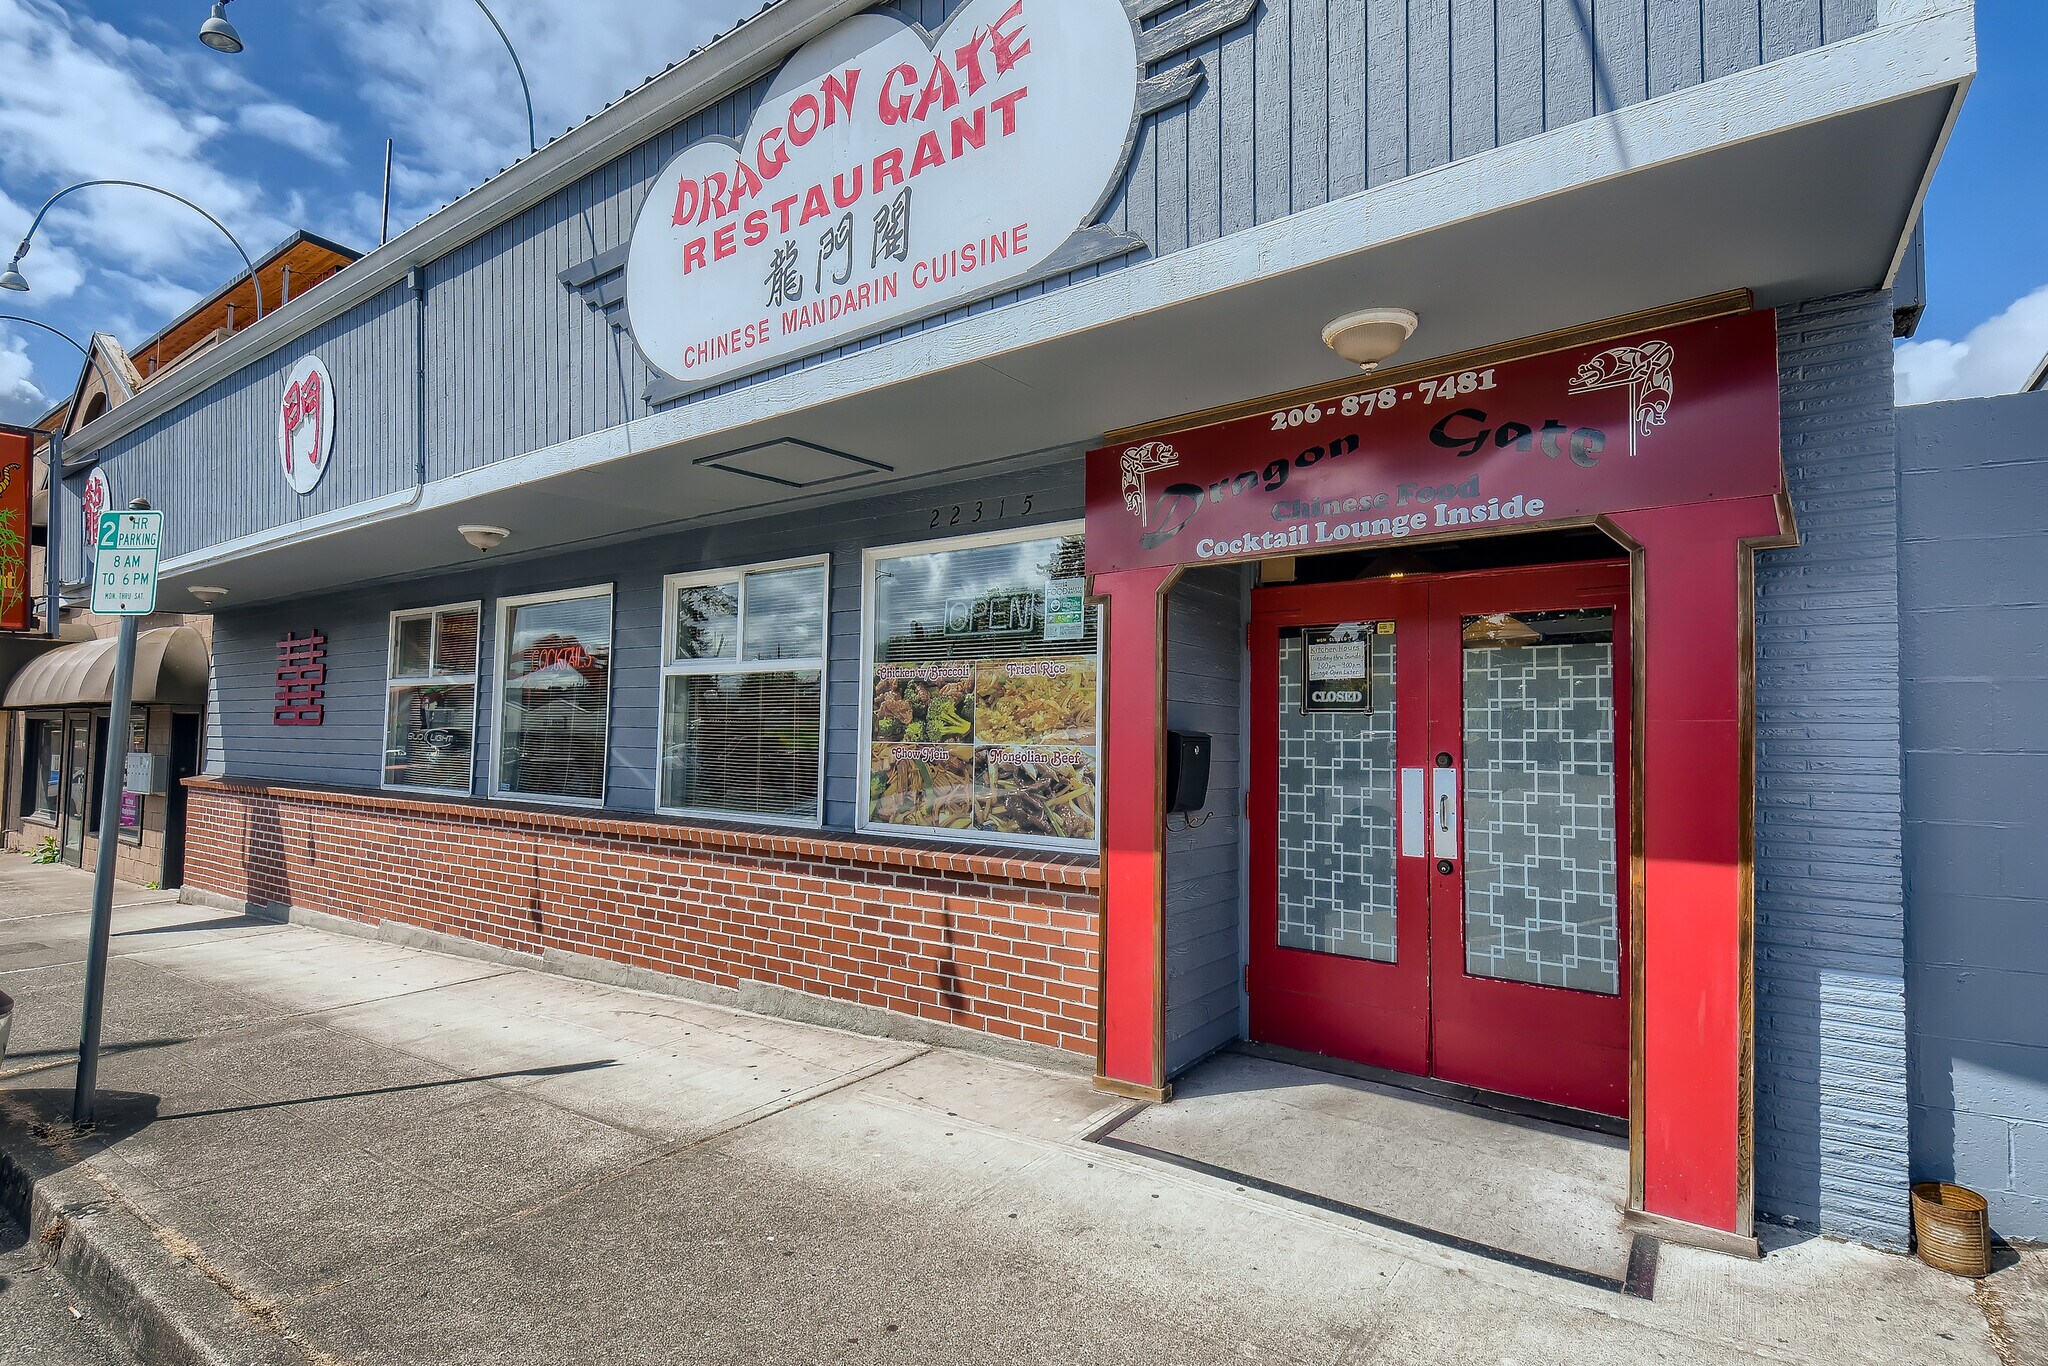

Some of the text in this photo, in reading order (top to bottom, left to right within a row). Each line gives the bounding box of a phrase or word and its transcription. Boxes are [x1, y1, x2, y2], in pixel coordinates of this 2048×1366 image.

[671, 0, 1032, 228] DRAGON GATE
[683, 86, 1029, 276] RESTAURANT
[684, 222, 1030, 369] CHINESE MANDARIN CUISINE
[283, 370, 323, 474] 門
[1138, 407, 1607, 550] Dragon Gate
[1270, 473, 1481, 522] Chinese Food
[132, 517, 149, 530] HR
[1196, 494, 1546, 558] Cocktail Lounge Inside
[100, 521, 116, 546] 2
[118, 532, 157, 546] PARKING
[113, 555, 141, 568] 8 AM
[102, 572, 149, 586] TO 6 PM
[119, 592, 132, 600] THRU
[1047, 586, 1068, 596] FOOD
[949, 593, 1034, 632] OPEN
[876, 666, 916, 680] Chicken
[1005, 660, 1067, 678] Fried Rice
[1311, 690, 1363, 703] CLOSED
[891, 746, 950, 762] Chow Mein
[989, 749, 1081, 767] Mongolian Beef
